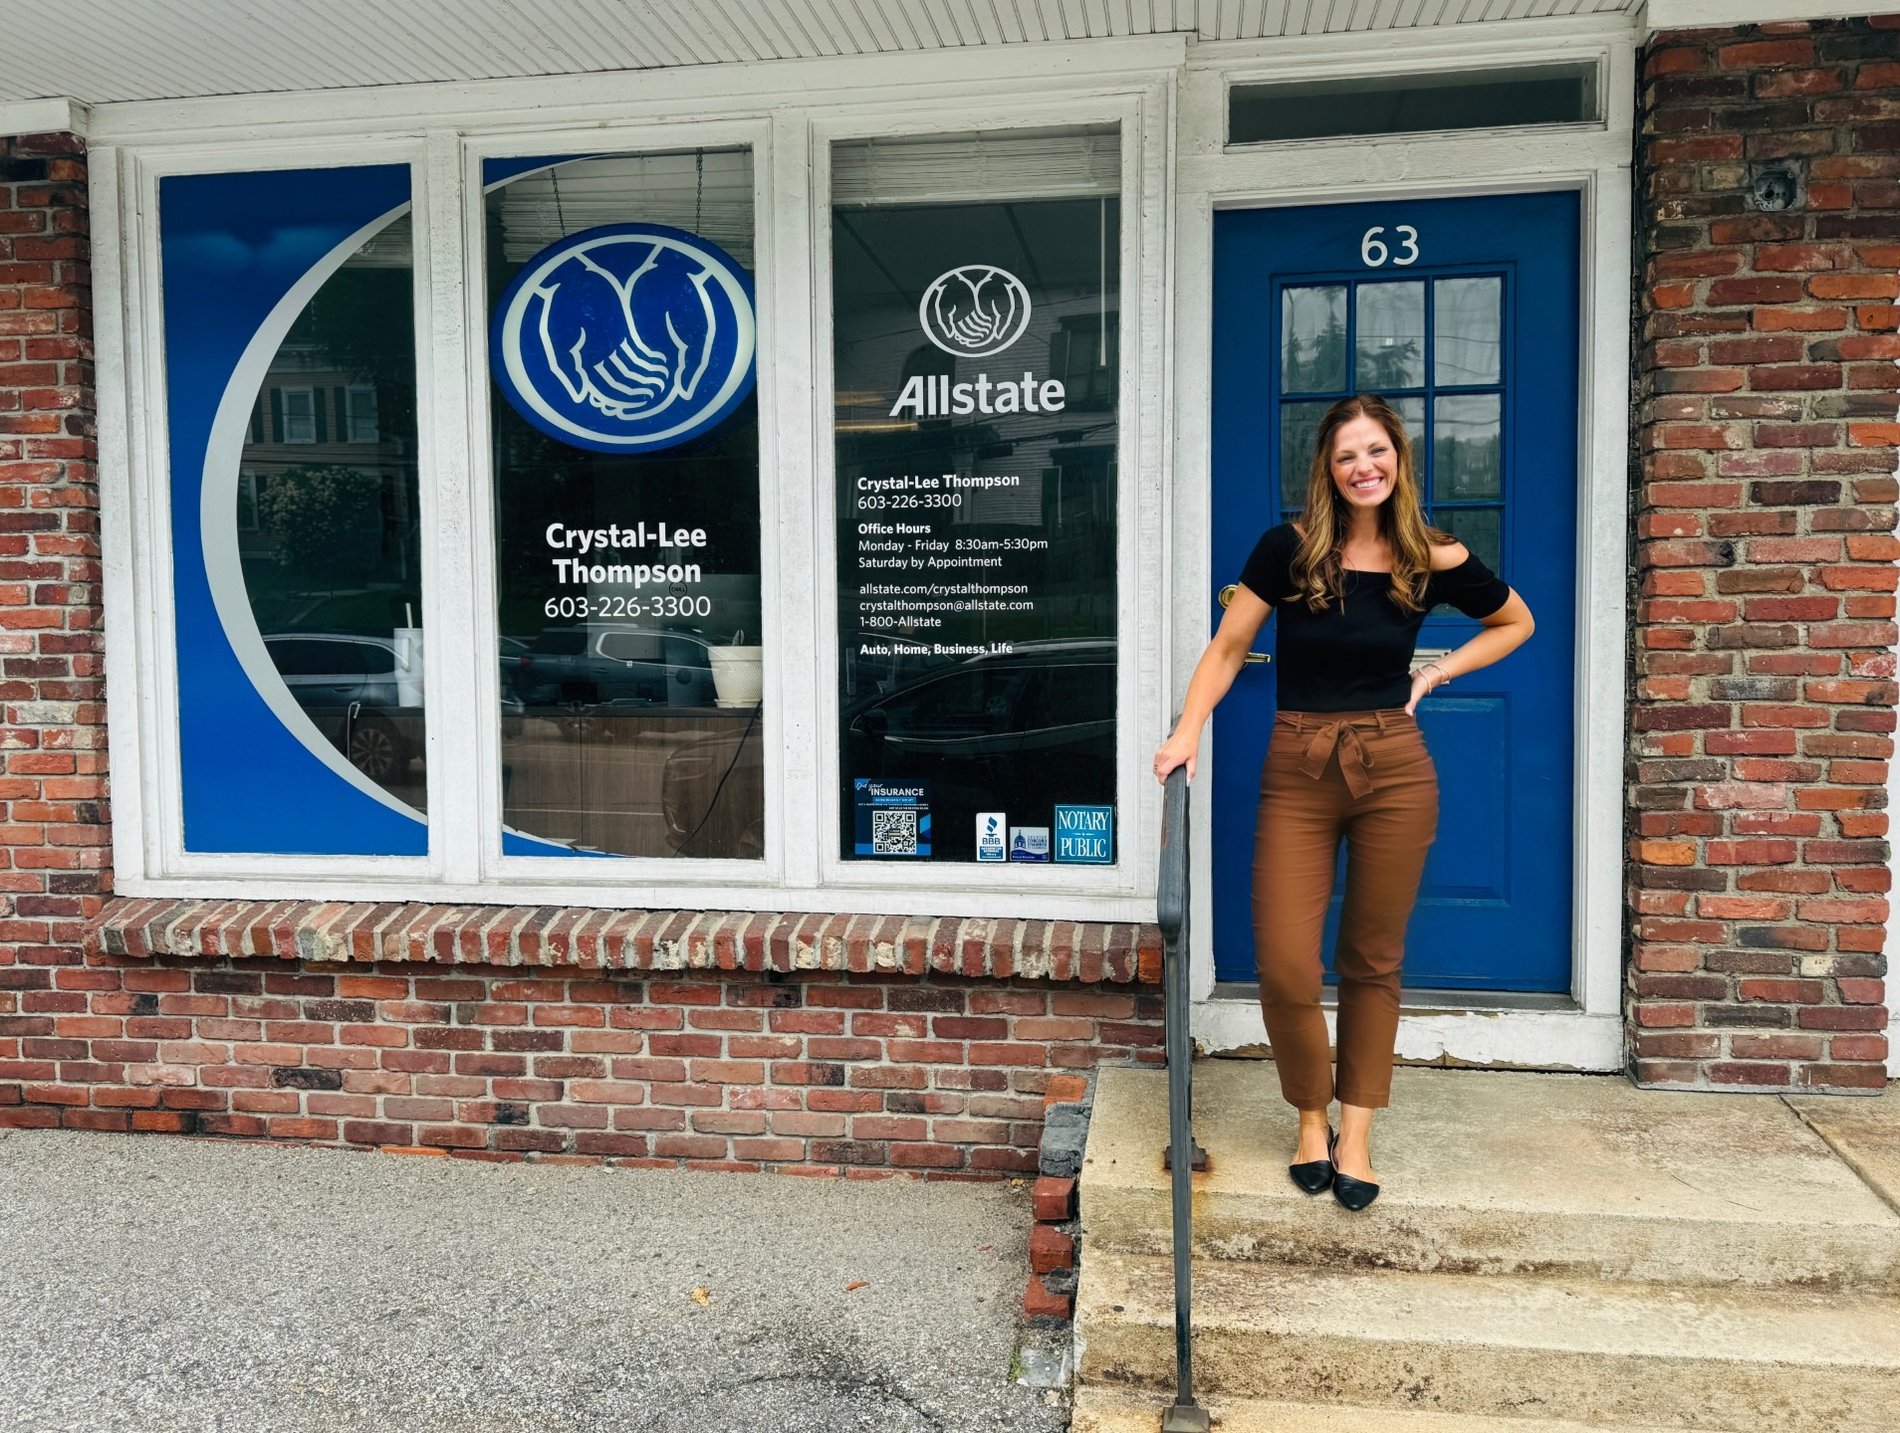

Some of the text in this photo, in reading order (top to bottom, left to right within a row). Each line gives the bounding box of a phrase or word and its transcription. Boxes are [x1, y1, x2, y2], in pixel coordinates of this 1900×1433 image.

[1361, 224, 1419, 267] 63
[888, 371, 1066, 417] Allstate
[857, 474, 1020, 493] Crystal-Lee Thompson
[857, 494, 962, 509] 603-226-3300
[858, 523, 931, 534] Office Hours
[546, 521, 707, 554] Crystal-Lee
[858, 540, 905, 552] Monday
[915, 539, 949, 552] Friday
[955, 538, 1048, 551] 8:30am-5:30pm
[858, 556, 1002, 570] Saturday by Appointment
[552, 558, 701, 589] Thompson
[859, 582, 1028, 595] allstate.com/crystalthompson
[544, 596, 711, 618] 603-226-3300
[859, 599, 1034, 612] crystalthompson@allstate.com
[860, 616, 942, 627] 1-800-Allstate
[860, 643, 1013, 656] Auto, Home, Business, Life
[870, 788, 924, 796] INSURANCE
[1058, 810, 1109, 831] NOTARY
[982, 837, 1001, 845] BBB
[1060, 837, 1106, 858] PUBLIC
